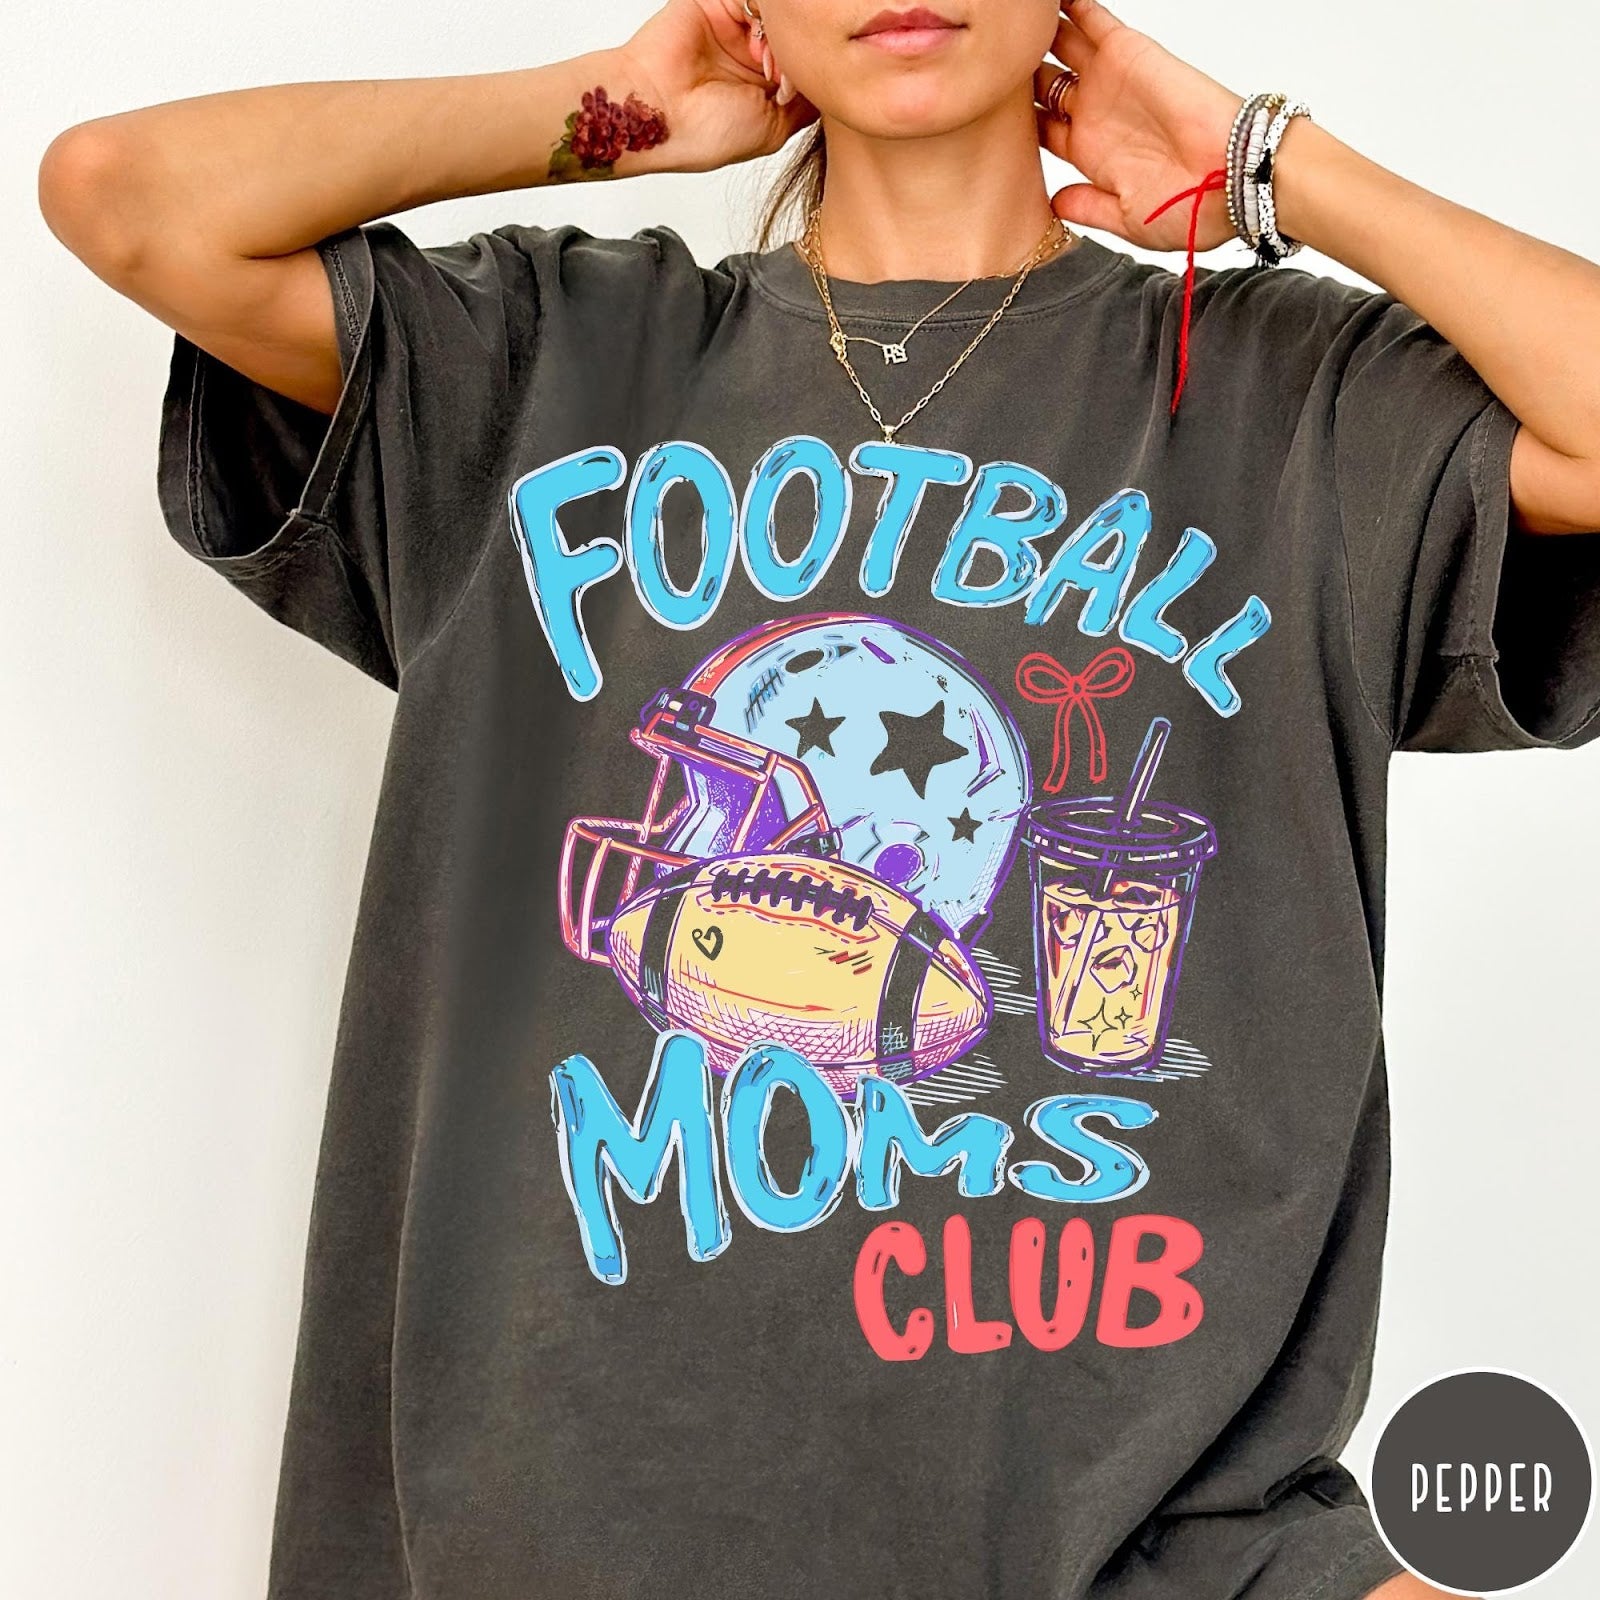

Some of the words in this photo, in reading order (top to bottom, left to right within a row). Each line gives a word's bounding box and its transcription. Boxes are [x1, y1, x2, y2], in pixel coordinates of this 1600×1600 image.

[508, 434, 1272, 718] FOOTBALL
[549, 1028, 1160, 1286] MOMS
[852, 1214, 1205, 1361] CLUB
